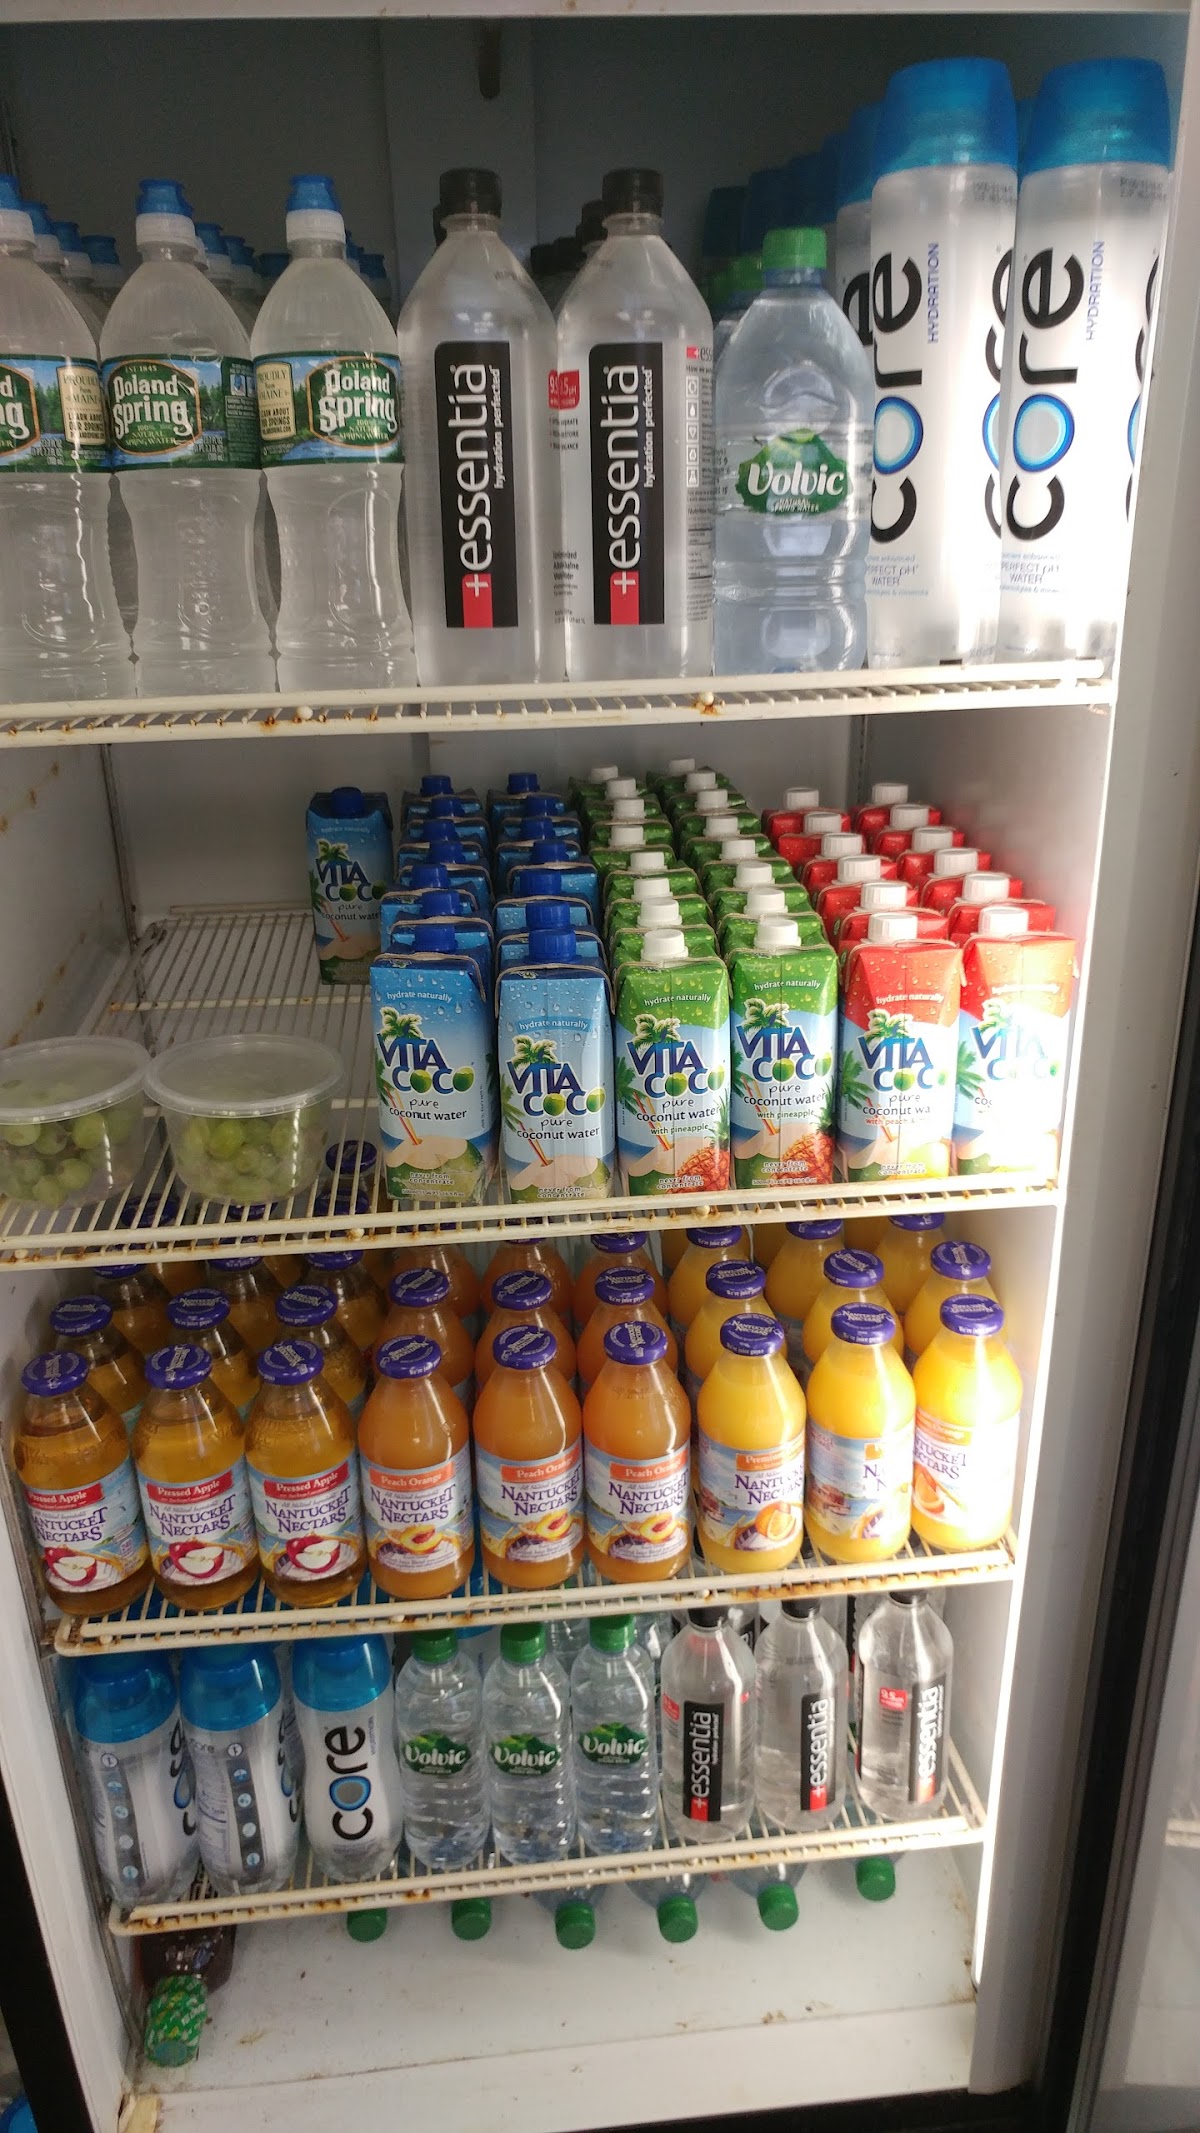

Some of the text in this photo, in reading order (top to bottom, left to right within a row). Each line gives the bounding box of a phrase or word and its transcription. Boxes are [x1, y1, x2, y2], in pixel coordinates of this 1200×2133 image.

[927, 243, 939, 343] HYDRATION
[1086, 242, 1105, 341] HYDRATION
[113, 374, 179, 402] Poland
[325, 368, 390, 396] Poland
[870, 252, 923, 544] core
[1006, 248, 1084, 541] core
[491, 366, 506, 489] hydration perfected
[641, 366, 656, 489] hydration perfected
[448, 364, 493, 571] essentia
[600, 365, 641, 569] essentia
[747, 460, 845, 496] Volvic
[315, 859, 371, 886] VITA
[338, 904, 363, 913] pure
[754, 980, 821, 990] hydrate naturally
[387, 991, 452, 1003] hydrate naturally
[644, 994, 712, 1006] hydrate naturally
[876, 994, 944, 1004] hydrate naturally
[519, 1020, 588, 1030] hydrate naturally
[377, 1034, 448, 1071] VITA
[736, 1025, 811, 1060] VITA
[858, 1036, 934, 1070] VITA
[626, 1040, 704, 1075] VITA
[506, 1061, 581, 1094] VITA
[744, 1095, 793, 1106] coconut
[769, 1084, 801, 1098] pure
[889, 1094, 921, 1107] pure
[389, 1107, 467, 1120] coconut water
[409, 1099, 439, 1110] pure
[662, 1099, 695, 1113] pure
[757, 1108, 815, 1120] with pineapple
[863, 1106, 912, 1116] coconut
[541, 1118, 573, 1131] pure
[636, 1111, 686, 1123] coconut
[517, 1127, 600, 1140] coconut water
[650, 1123, 709, 1135] with pineapple
[276, 1471, 338, 1492] Pressed Apple
[381, 1473, 442, 1486] Peach Orange
[501, 1463, 582, 1501] NANTUCKET
[516, 1468, 544, 1478] Peach
[625, 1467, 653, 1477] Peach
[157, 1480, 221, 1496] Pressed Apple
[608, 1468, 689, 1501] NANTUCKET
[59, 1491, 87, 1504] Apple
[149, 1494, 237, 1524] NANTUCKET
[265, 1485, 351, 1519] NANTUCKET
[370, 1483, 456, 1512] NANTUCKET
[514, 1485, 578, 1516] NECTARS
[619, 1489, 684, 1516] NECTARS
[277, 1506, 347, 1534] NECTARS
[380, 1503, 449, 1523] NECTARS
[35, 1526, 102, 1543] NECTARS
[160, 1514, 231, 1537] NECTARS
[807, 1698, 829, 1787] essentia
[917, 1686, 939, 1778] essentia
[405, 1744, 467, 1767] Volvic
[494, 1745, 556, 1768] Volvic
[583, 1734, 645, 1756] Volvic
[689, 1710, 712, 1797] essentia
[324, 1724, 374, 1841] core
